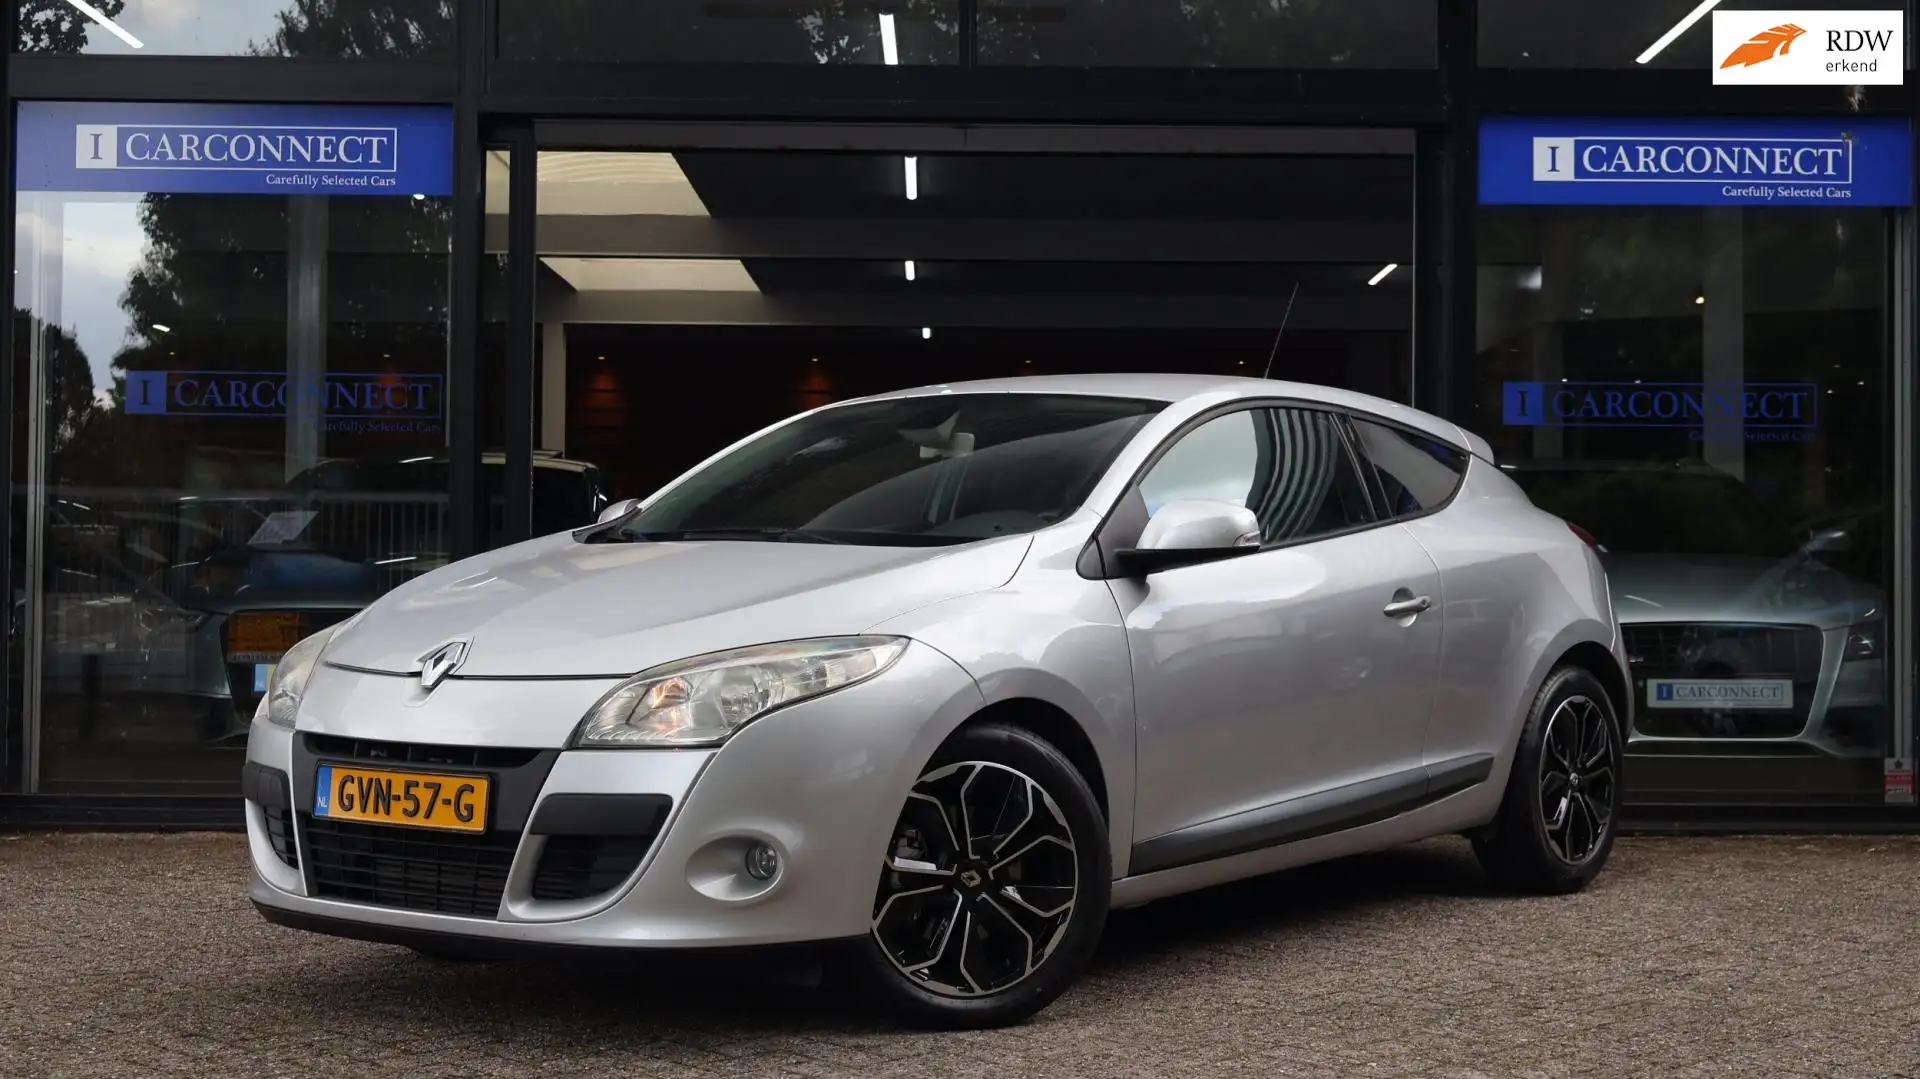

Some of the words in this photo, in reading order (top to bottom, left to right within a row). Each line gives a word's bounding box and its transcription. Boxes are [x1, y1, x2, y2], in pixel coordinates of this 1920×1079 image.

[89, 132, 103, 160] I
[125, 132, 388, 164] CARCONNECT
[1547, 145, 1560, 173] I
[1582, 144, 1843, 176] CARCONNECT
[265, 173, 319, 189] Carefully
[321, 174, 367, 186] Selected
[370, 175, 396, 187] Cars
[1721, 185, 1775, 201] Carefully
[1776, 186, 1823, 199] Selected
[1825, 187, 1852, 199] Cars
[140, 379, 149, 407] I
[173, 378, 433, 411] CARCONNECT
[1516, 390, 1528, 417] I
[1676, 685, 1781, 700] CARCONNECT
[317, 796, 327, 808] NL
[338, 774, 475, 822] GVN-57-G
